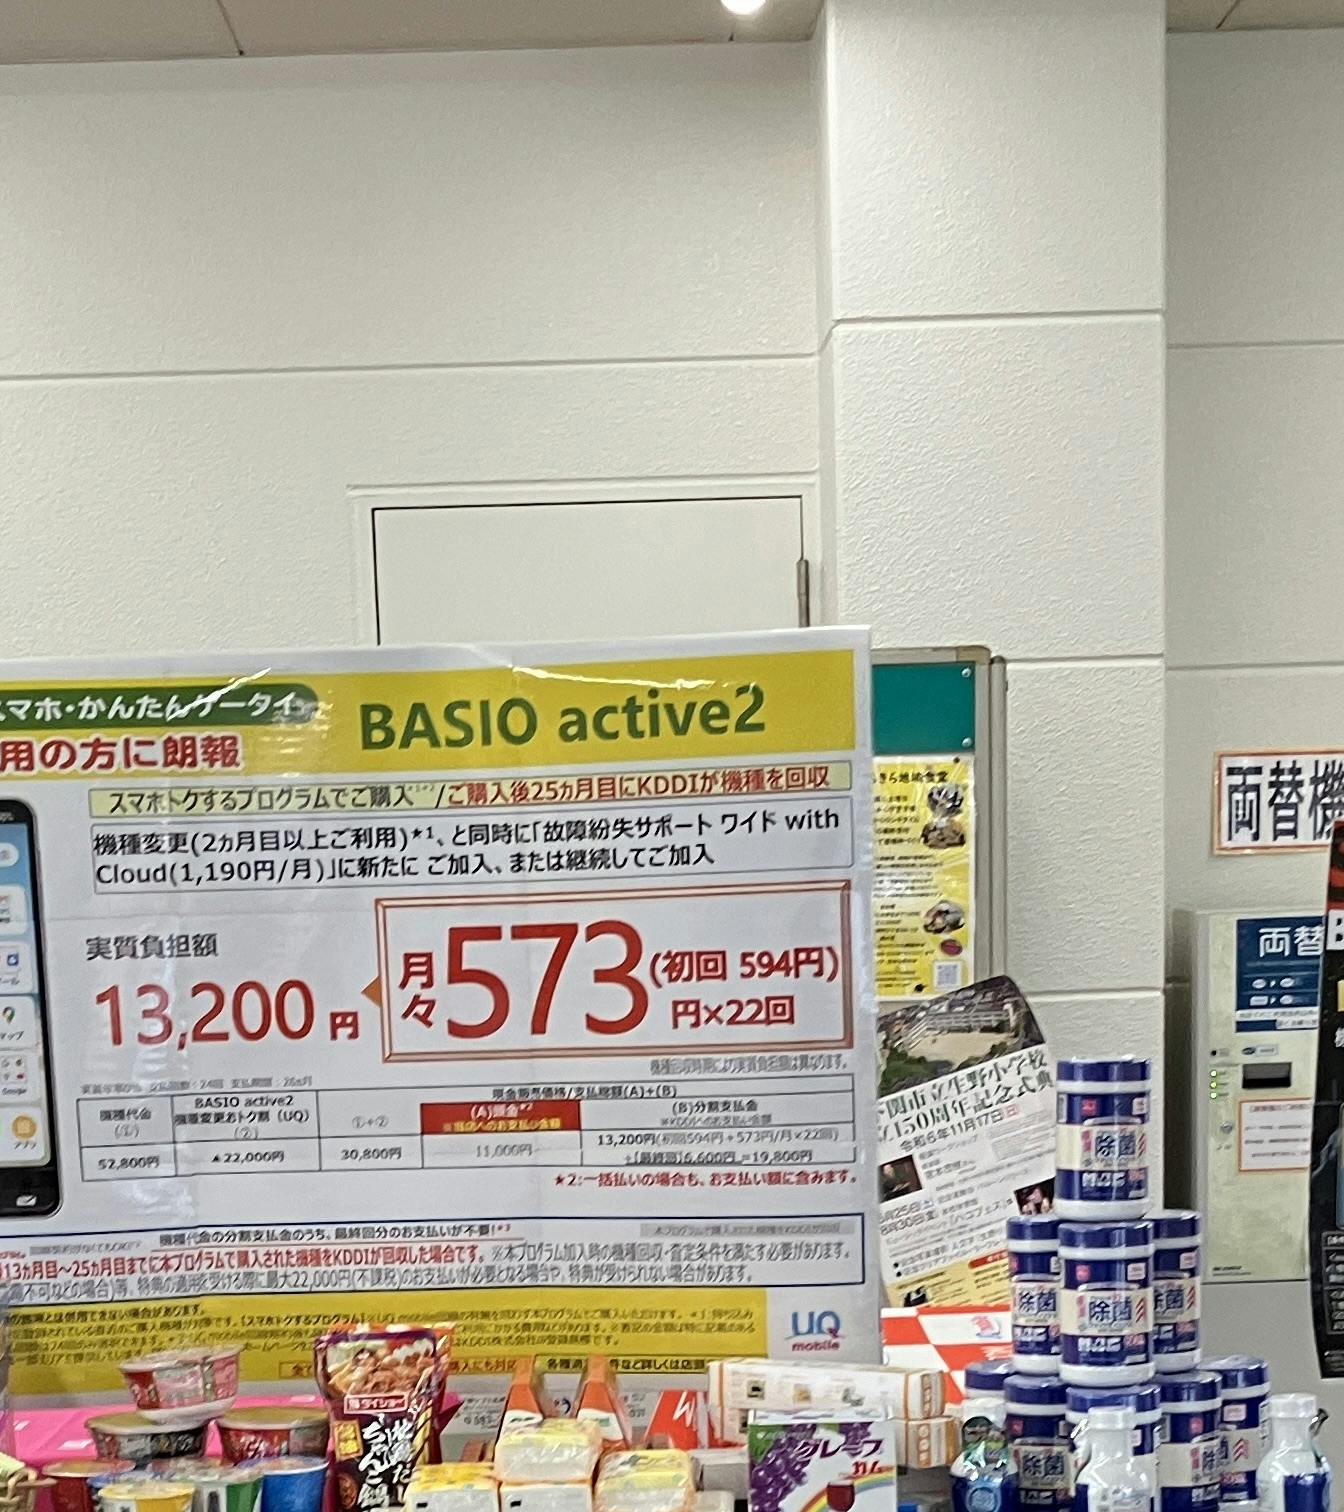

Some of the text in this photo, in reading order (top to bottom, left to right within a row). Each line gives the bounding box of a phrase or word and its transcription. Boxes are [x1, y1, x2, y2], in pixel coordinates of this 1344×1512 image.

[359, 682, 766, 751] BASIO active2
[720, 810, 777, 836] ワイド
[785, 807, 840, 831] with
[428, 842, 715, 876] ご加入、または継続してご加入
[85, 932, 219, 963] 実質負担額
[397, 919, 650, 1040] 月々 573
[649, 946, 840, 989] (初回 594円)
[94, 979, 360, 1052] 13,200 円
[671, 996, 796, 1030] 円×22回
[194, 1094, 294, 1109] BASIO active2
[97, 1155, 160, 1171] 52,800円
[340, 1146, 403, 1163] 30,800円
[790, 1309, 842, 1338] UQ
[792, 1340, 840, 1352] mobile
